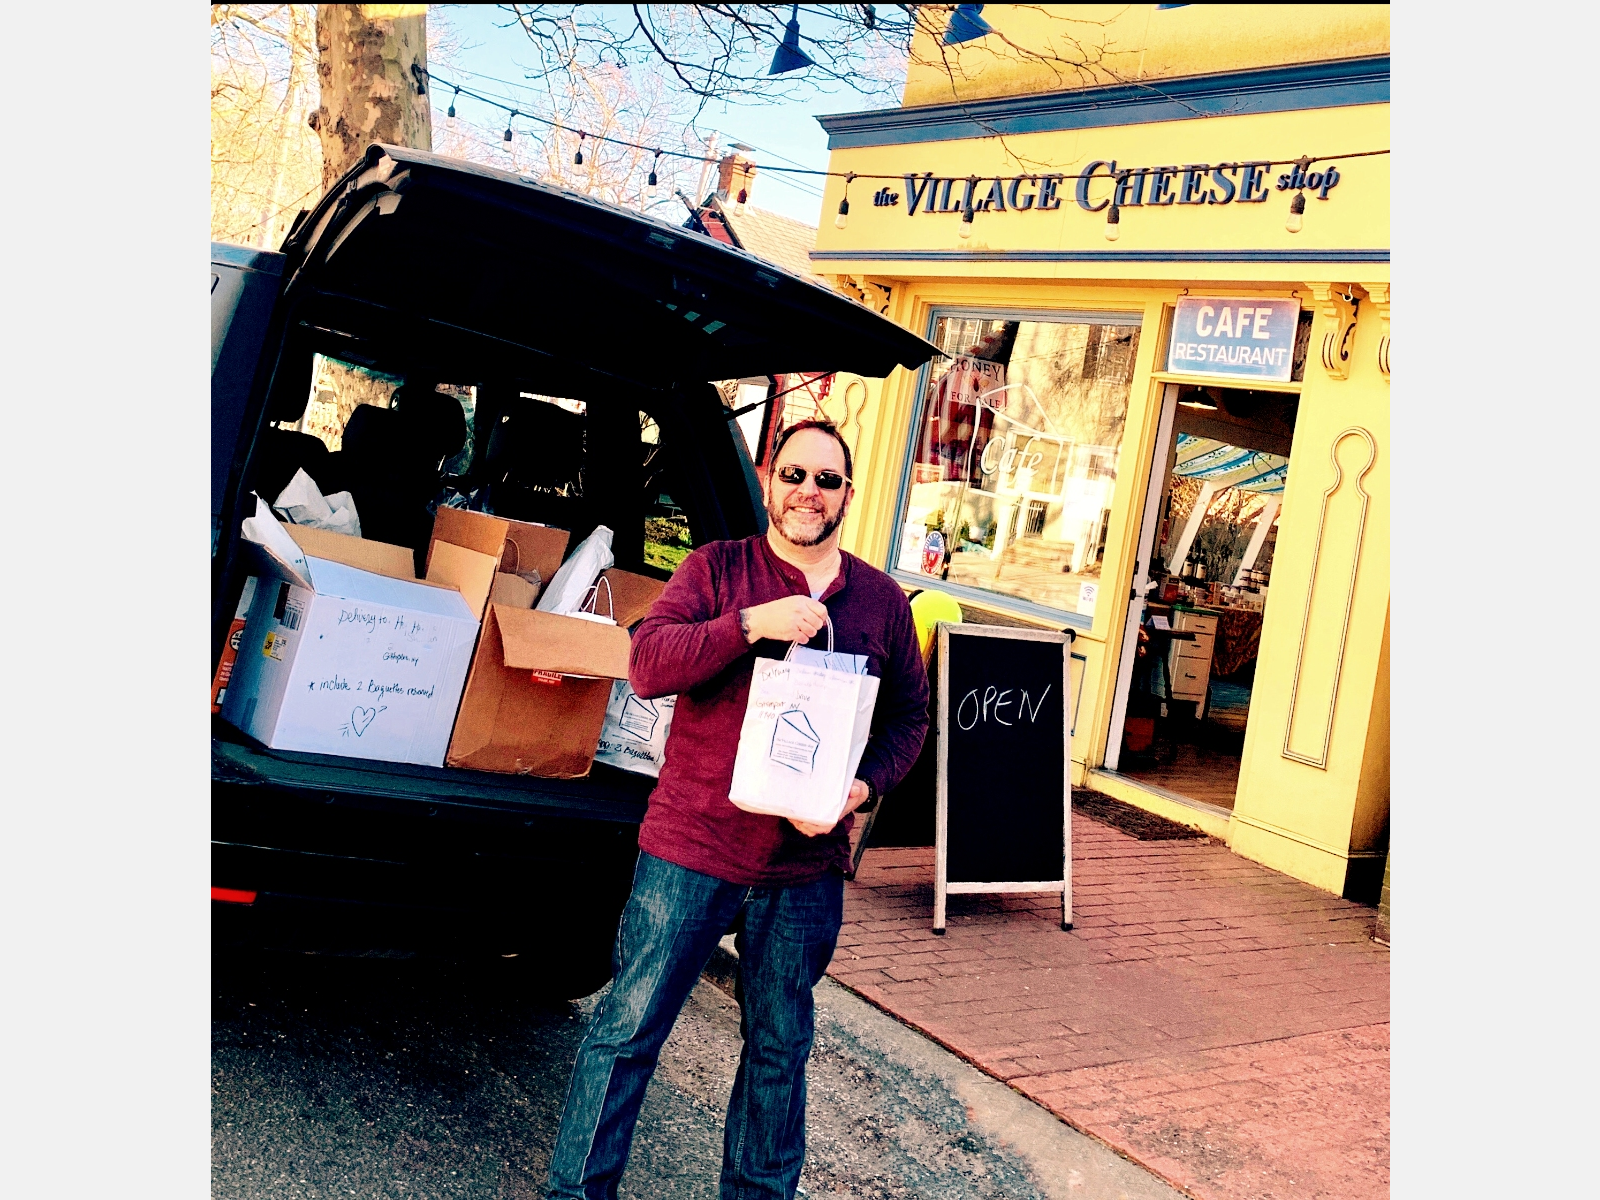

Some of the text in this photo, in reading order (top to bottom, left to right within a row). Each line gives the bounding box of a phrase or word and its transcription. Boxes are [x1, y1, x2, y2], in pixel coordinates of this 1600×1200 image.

[873, 160, 1340, 216] the VILLAGE CHEESE shop
[1195, 305, 1273, 340] CAFE
[1174, 342, 1287, 366] RESTAURANT
[951, 358, 1001, 382] HONEY
[951, 391, 1001, 409] FOR LE
[320, 674, 351, 691] include
[356, 681, 362, 691] 2
[957, 683, 1052, 731] OPEN
